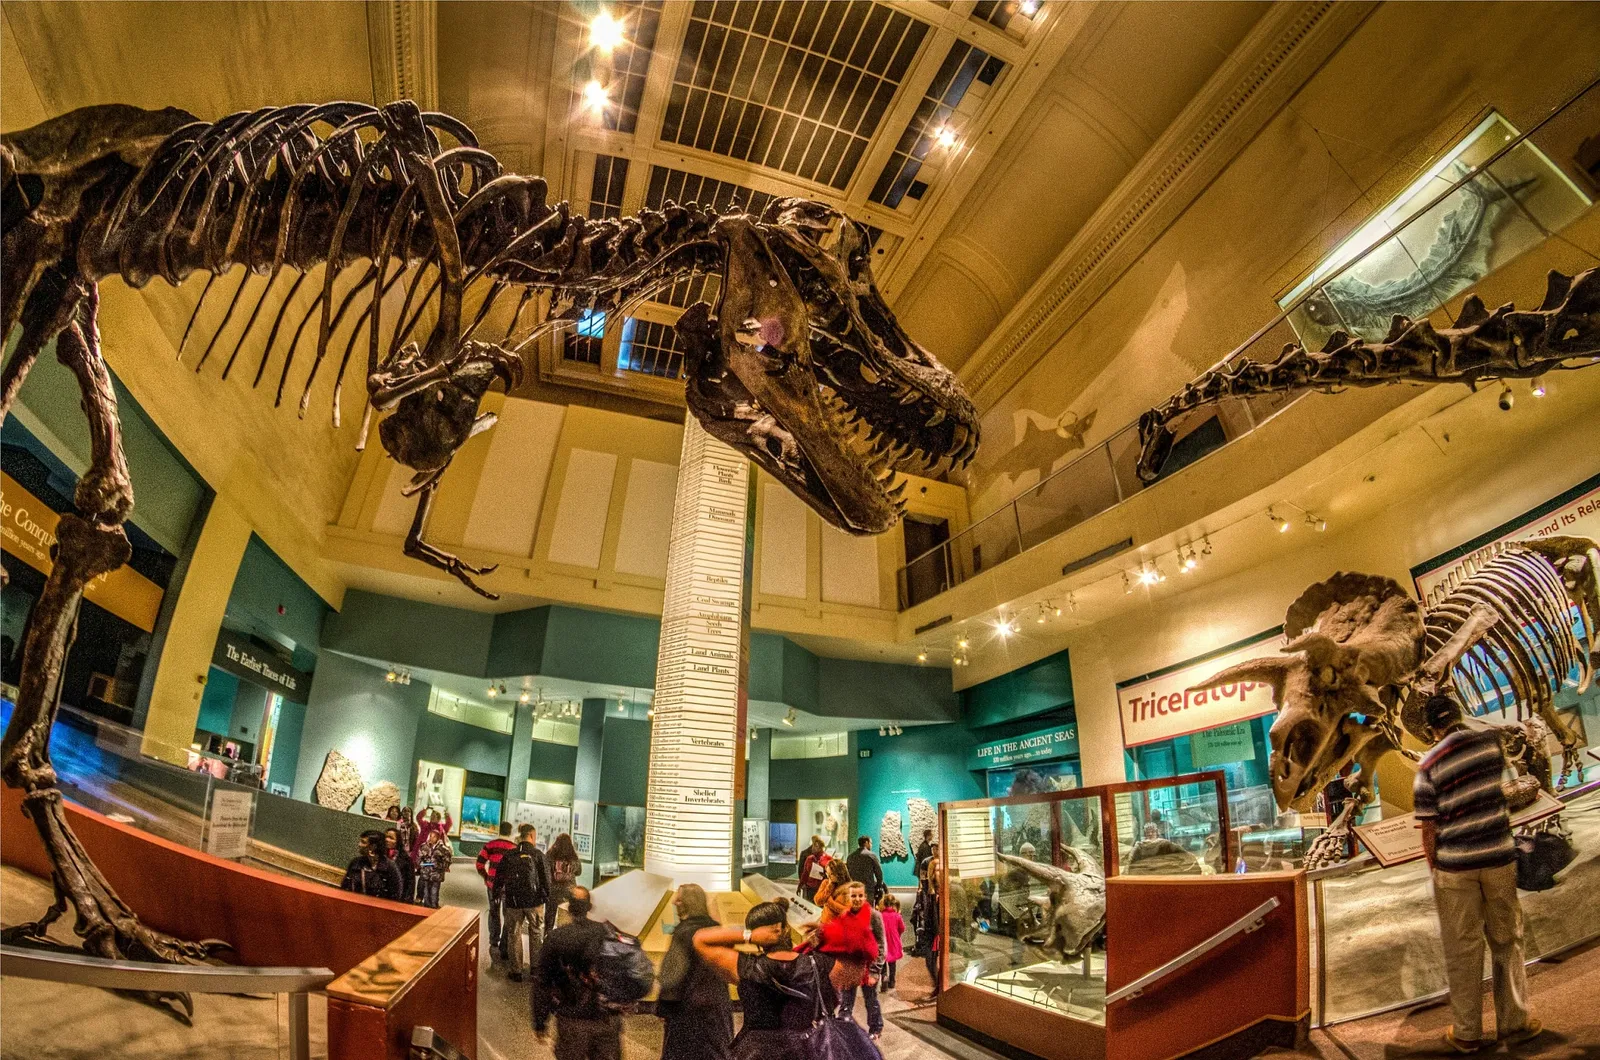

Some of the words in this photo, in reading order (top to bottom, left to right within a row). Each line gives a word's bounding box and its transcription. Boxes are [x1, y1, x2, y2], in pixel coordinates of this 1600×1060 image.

[709, 507, 736, 517] Mammals
[708, 514, 735, 523] Dinosaurs
[1537, 519, 1559, 537] and
[1560, 513, 1576, 527] Its
[706, 576, 728, 584] Reptiles
[696, 596, 711, 604] Coal
[711, 598, 735, 607] Swamps
[697, 611, 733, 621] Amphibians
[691, 648, 707, 656] Land
[709, 650, 734, 659] Animals
[226, 643, 240, 662] The
[240, 652, 262, 674] Earliest
[262, 662, 279, 682] Traces
[279, 673, 287, 685] of
[286, 675, 297, 691] Life
[693, 664, 709, 672] Land
[711, 666, 730, 674] Plants
[1128, 681, 1269, 723] Triceratop
[690, 737, 725, 748] Vertebrates
[977, 746, 993, 758] LIFE
[993, 744, 1002, 755] IN
[1002, 742, 1018, 753] THE
[1019, 733, 1053, 750] ANCIENT
[1054, 729, 1075, 743] SEAS
[693, 789, 717, 797] Shelled
[684, 796, 726, 806] Invertebrates
[1374, 825, 1407, 836] Triceratops
[1387, 848, 1409, 856] Please
